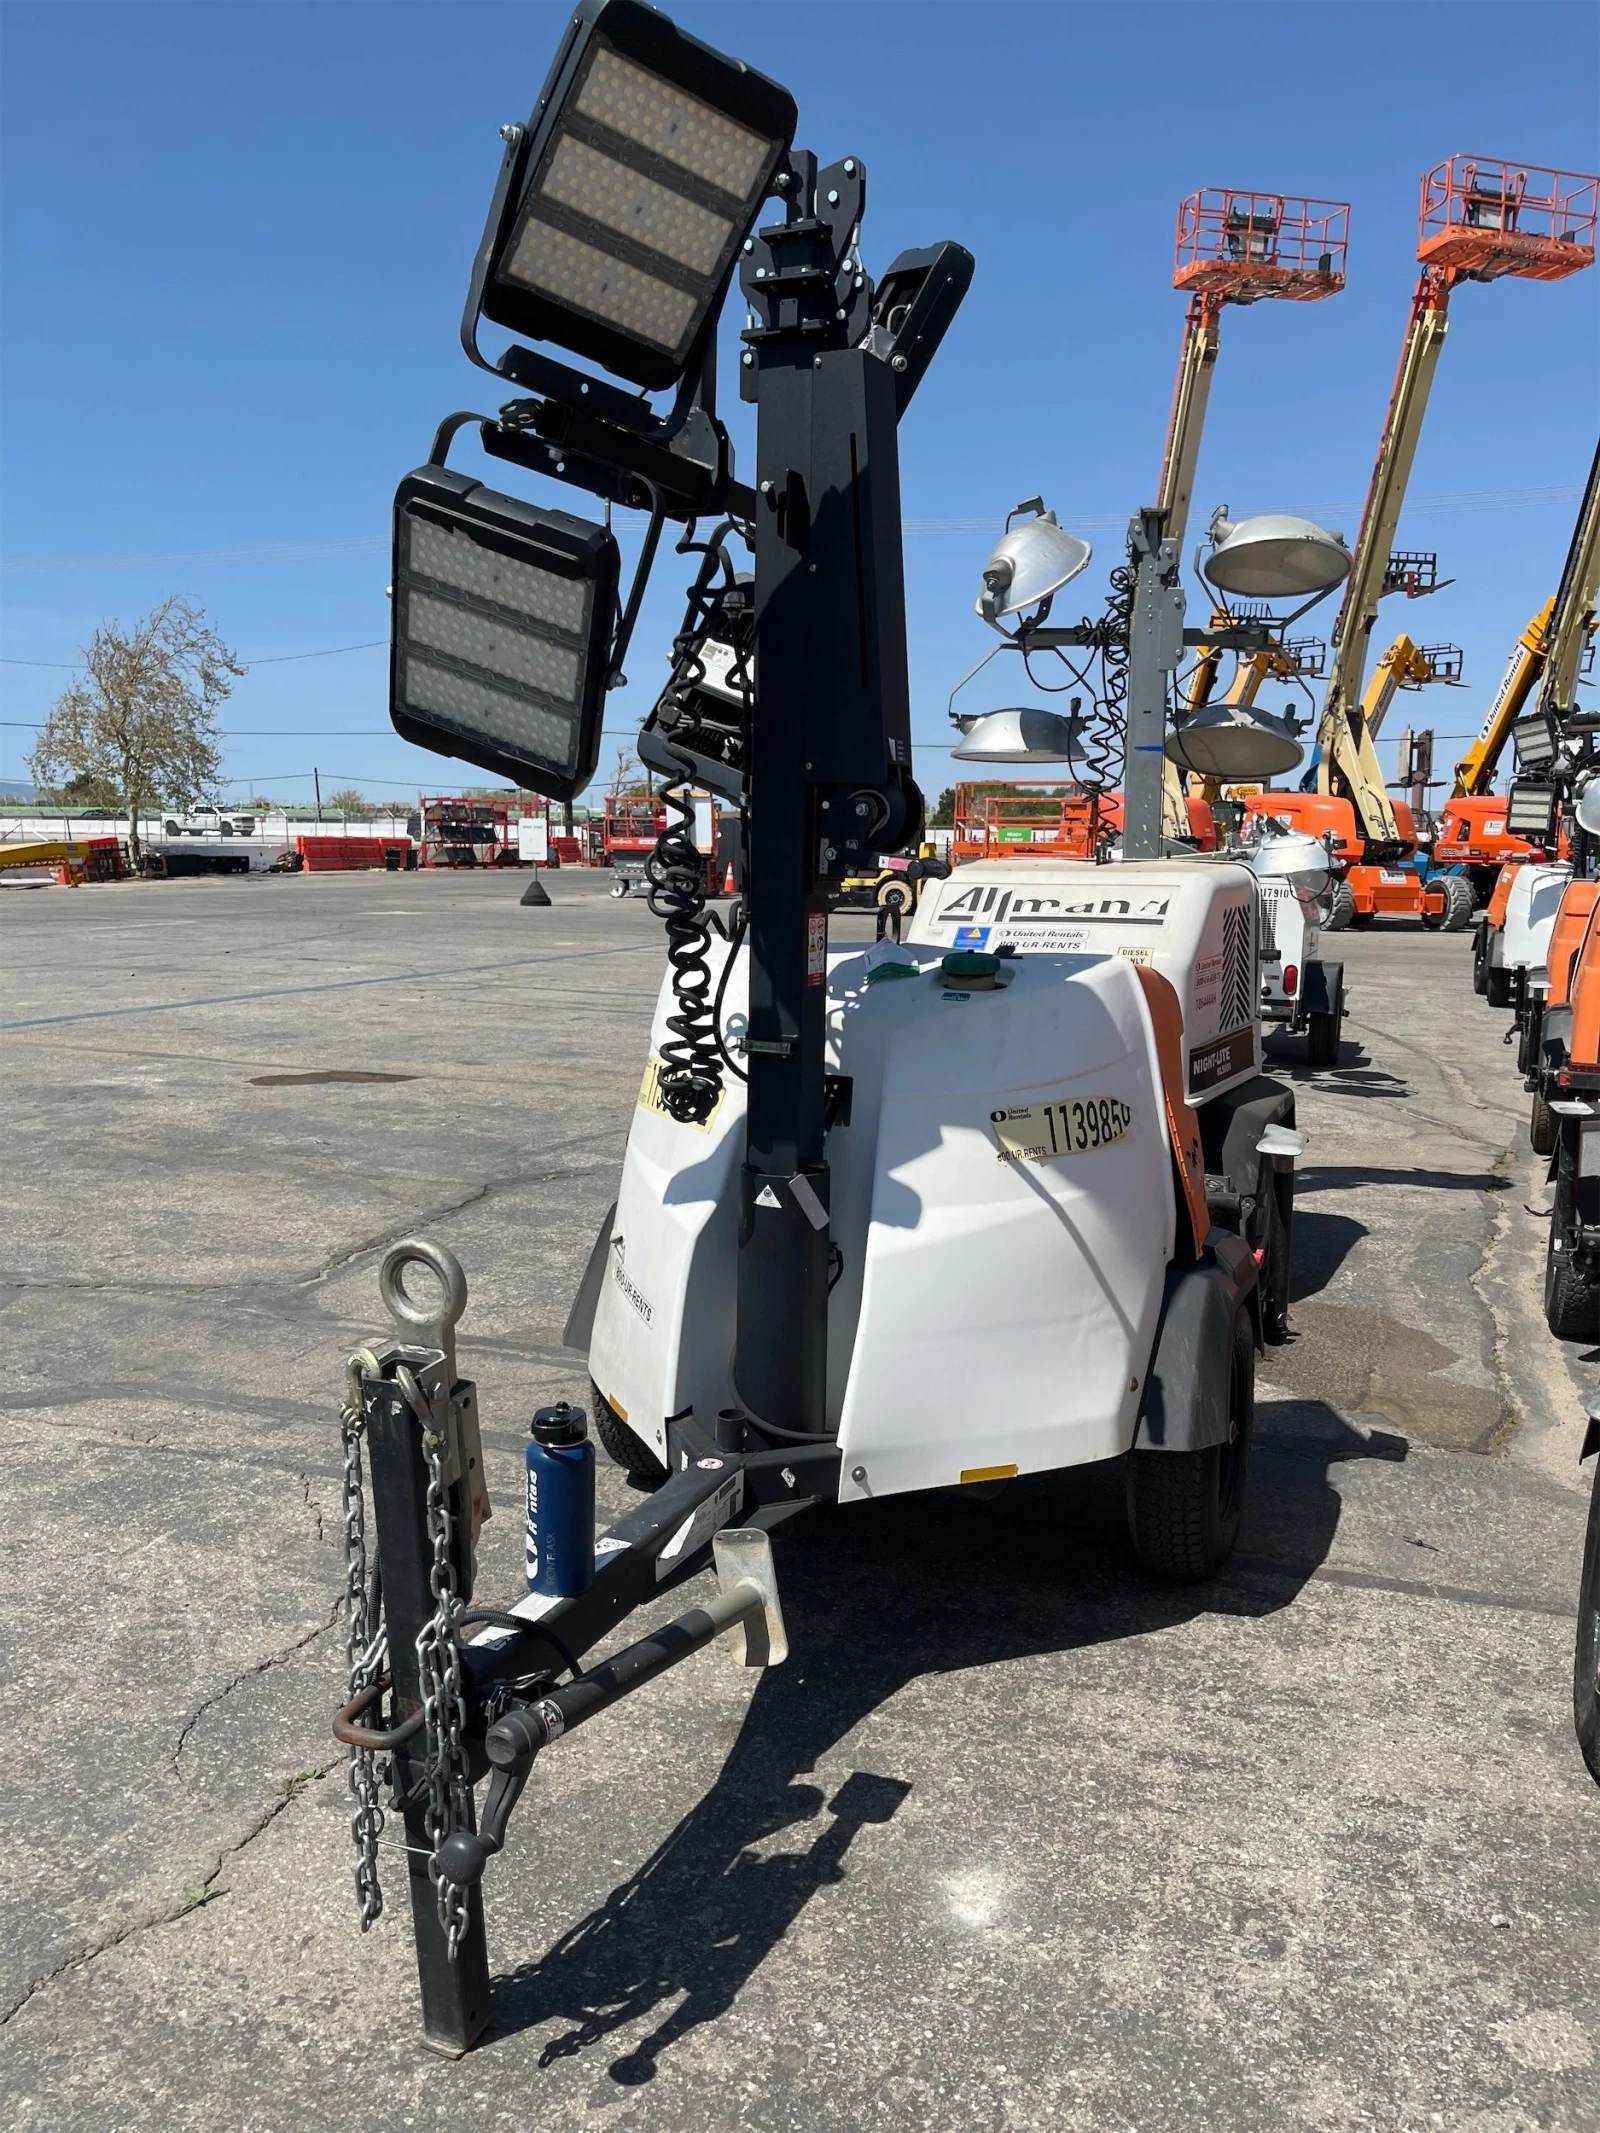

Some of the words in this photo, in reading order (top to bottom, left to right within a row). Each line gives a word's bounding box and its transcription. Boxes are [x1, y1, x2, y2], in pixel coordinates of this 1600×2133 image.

[1487, 689, 1506, 726] United
[1504, 650, 1524, 690] Rentals
[943, 887, 1171, 922] Allmand
[1013, 930, 1045, 938] United
[1129, 957, 1145, 965] NLY
[1193, 1045, 1232, 1076] NIGHT-LITE
[1008, 1107, 1029, 1115] United
